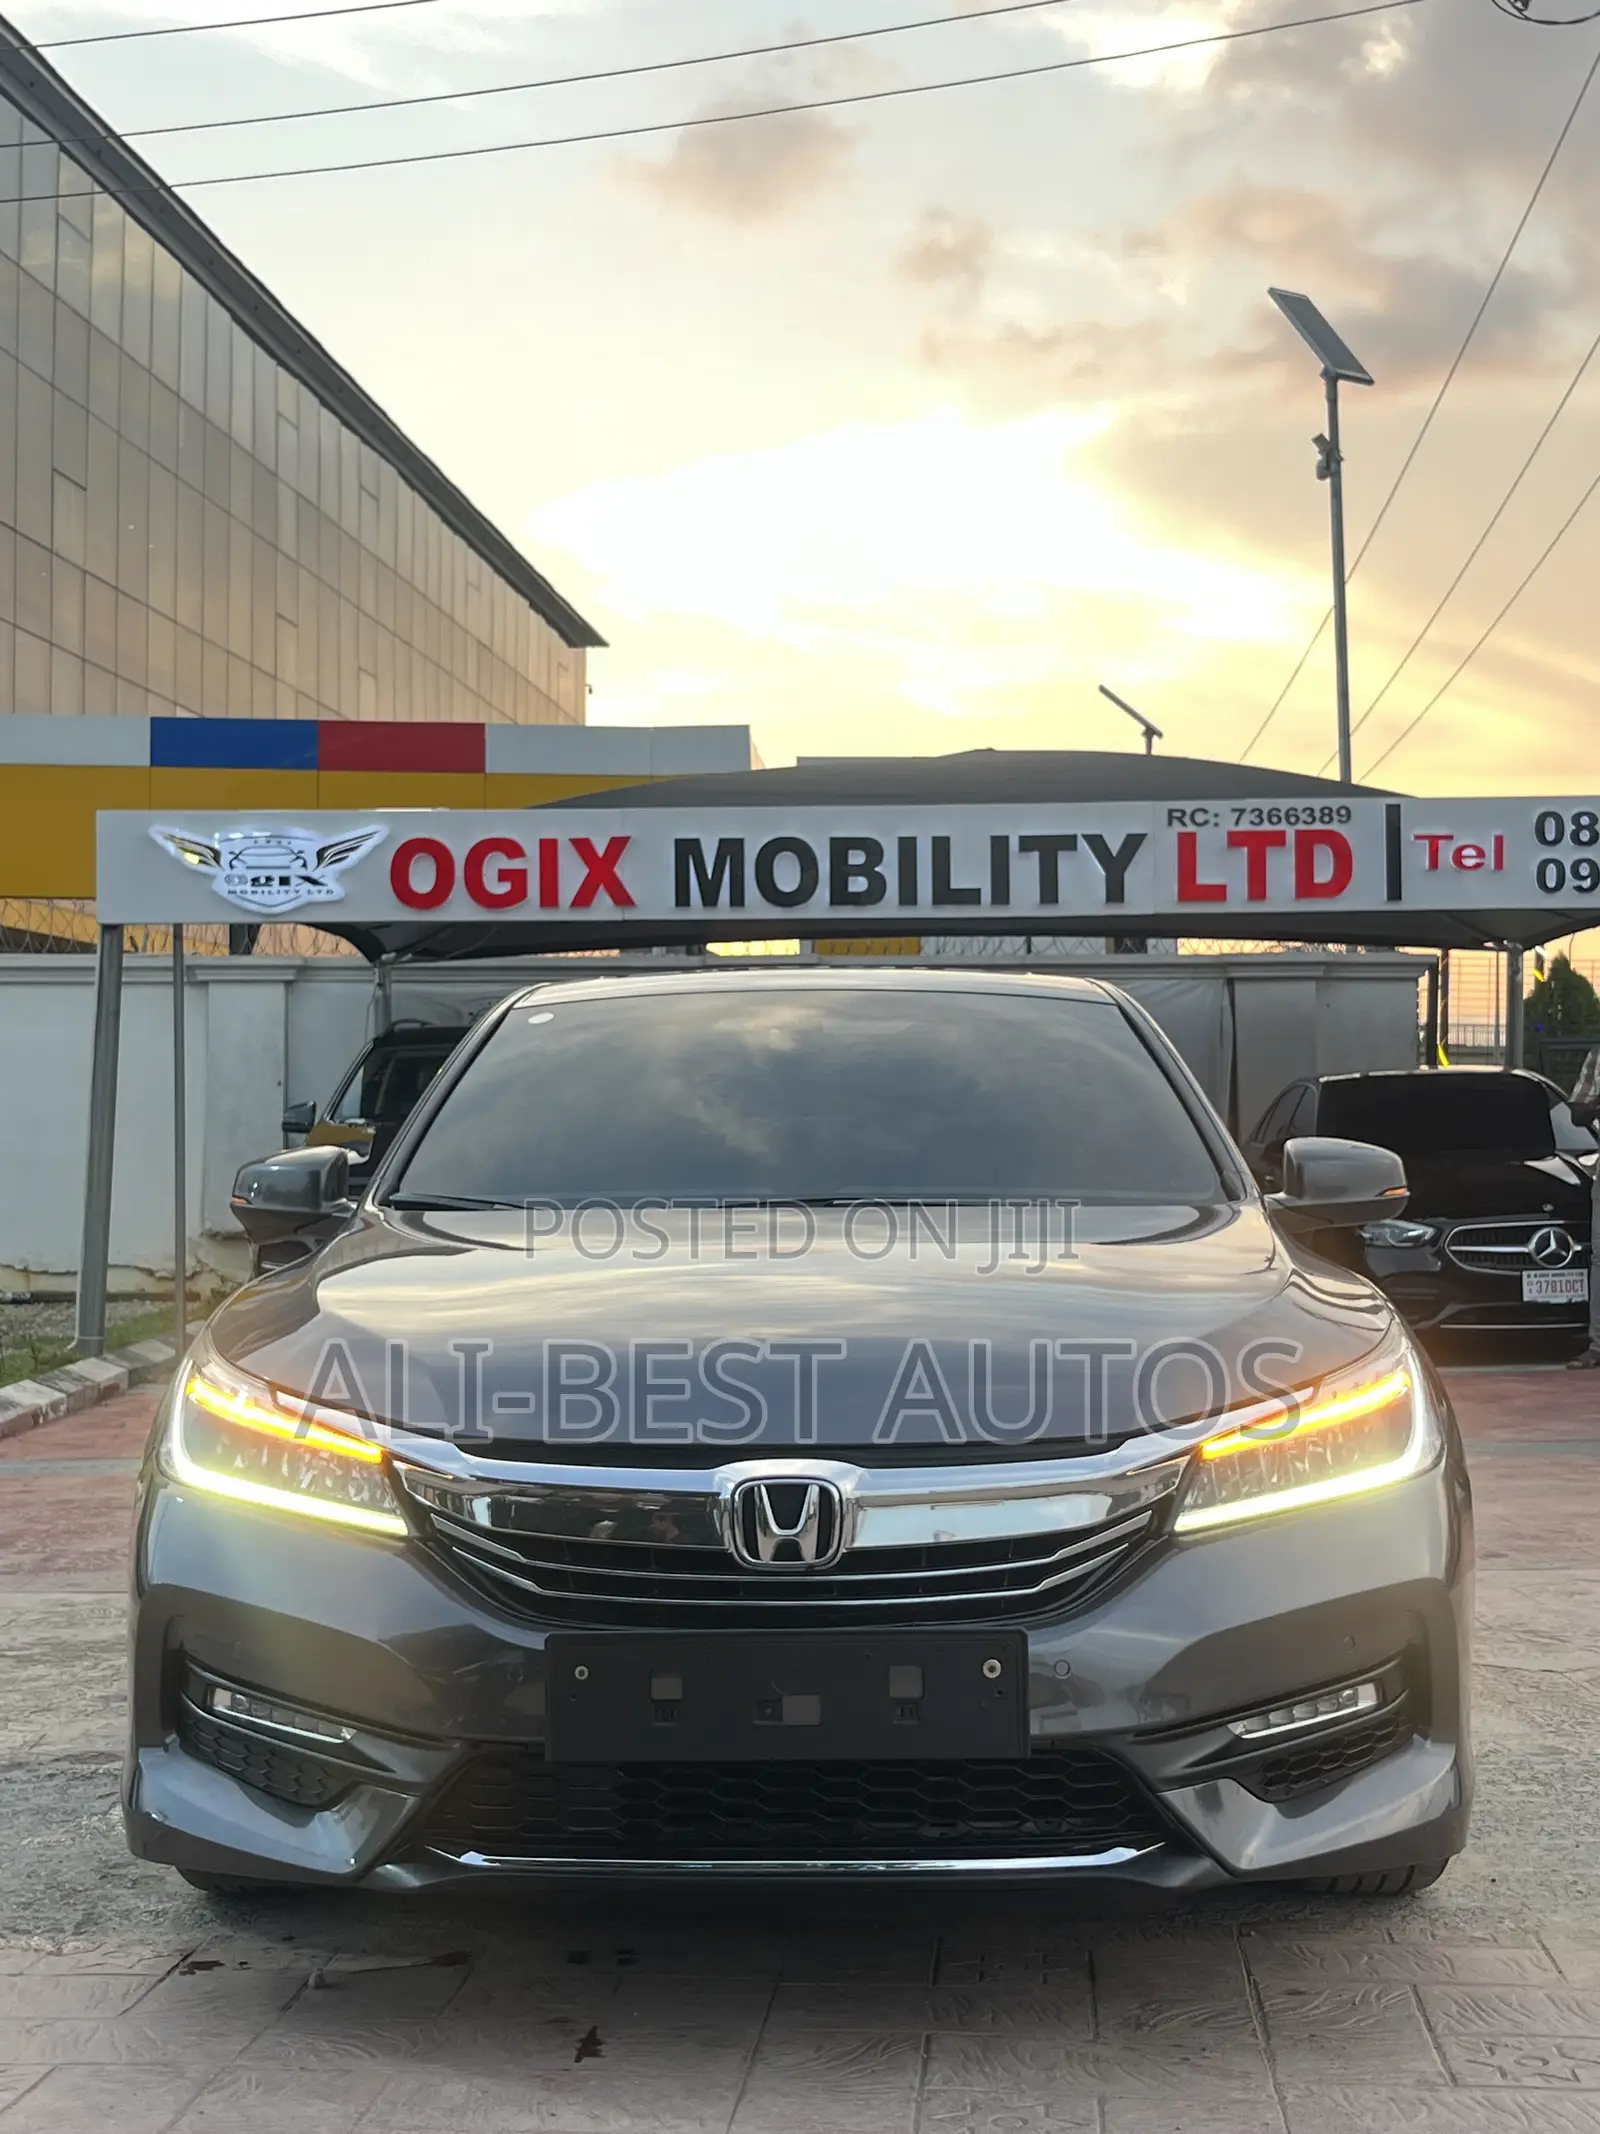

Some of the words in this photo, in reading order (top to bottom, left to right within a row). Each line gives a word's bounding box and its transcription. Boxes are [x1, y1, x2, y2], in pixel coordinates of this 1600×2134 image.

[1167, 808, 1221, 827] RC:
[1230, 805, 1352, 827] 7366389
[1535, 811, 1600, 847] 08
[390, 836, 637, 911] OGIX
[674, 833, 1148, 908] MOBILITY
[1177, 829, 1354, 903] LTD
[1412, 834, 1505, 871] Tel
[1536, 858, 1600, 893] 09
